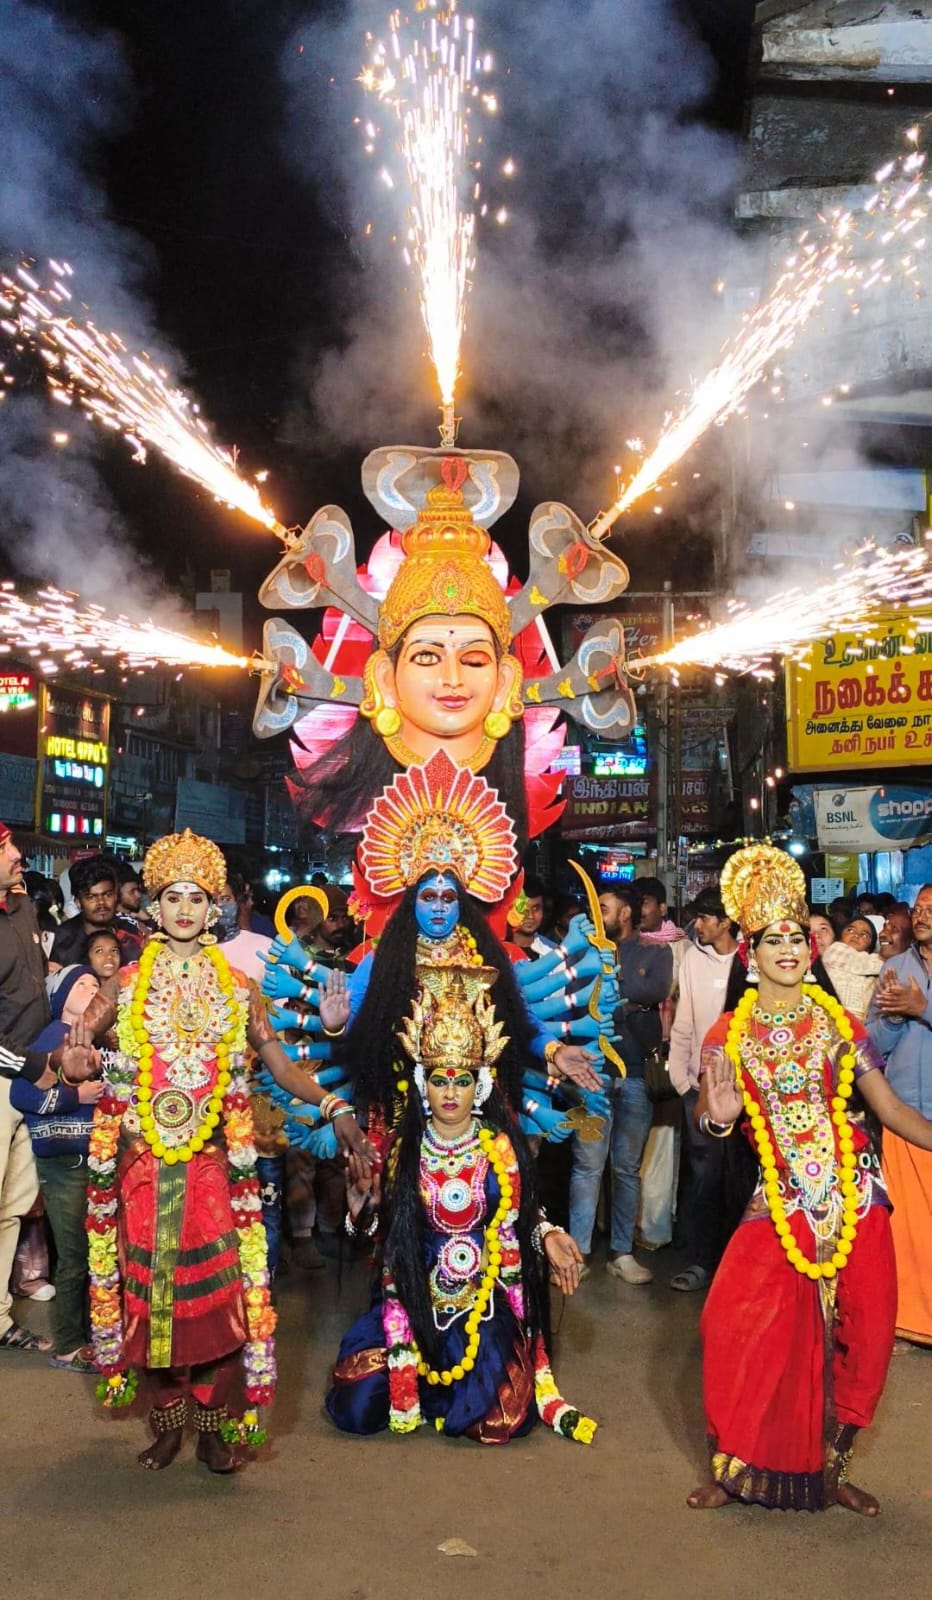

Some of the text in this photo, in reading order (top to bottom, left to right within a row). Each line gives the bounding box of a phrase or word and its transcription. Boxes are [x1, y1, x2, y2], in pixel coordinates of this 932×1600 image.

[811, 661, 912, 719] நகைக்
[866, 715, 908, 730] வேலை
[47, 736, 77, 759] HOTEL
[574, 800, 649, 816] INDIAN
[826, 811, 858, 824] BSNL
